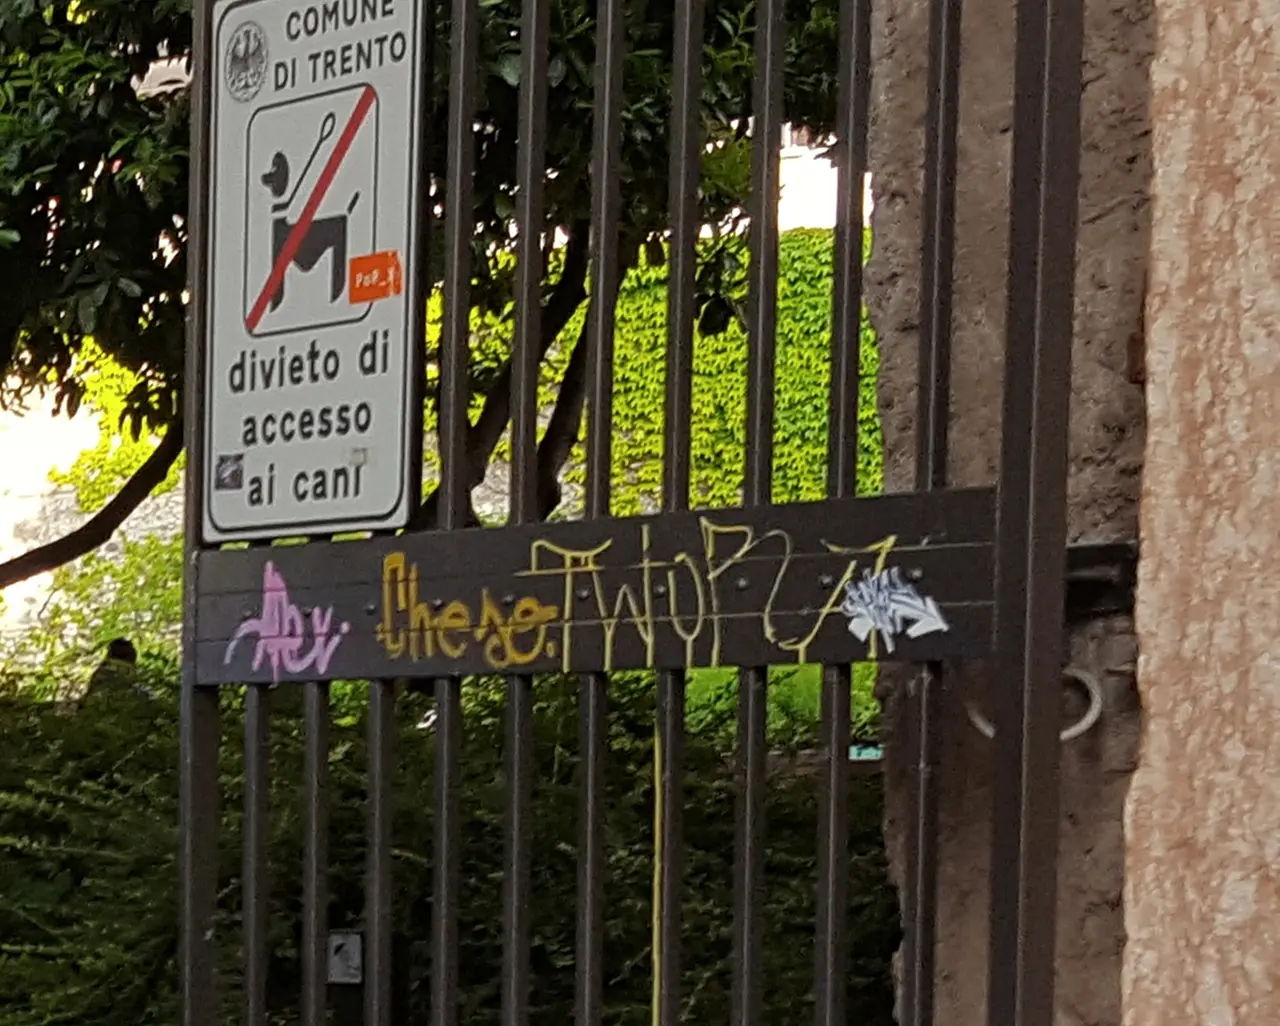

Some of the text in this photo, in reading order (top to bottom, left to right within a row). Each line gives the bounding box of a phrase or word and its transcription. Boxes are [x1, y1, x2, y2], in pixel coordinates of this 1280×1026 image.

[286, 0, 394, 41] COMUNE
[274, 32, 406, 91] DI TRENTO
[228, 330, 389, 394] divieto di
[242, 402, 372, 447] accesso
[247, 463, 362, 506] ai cani
